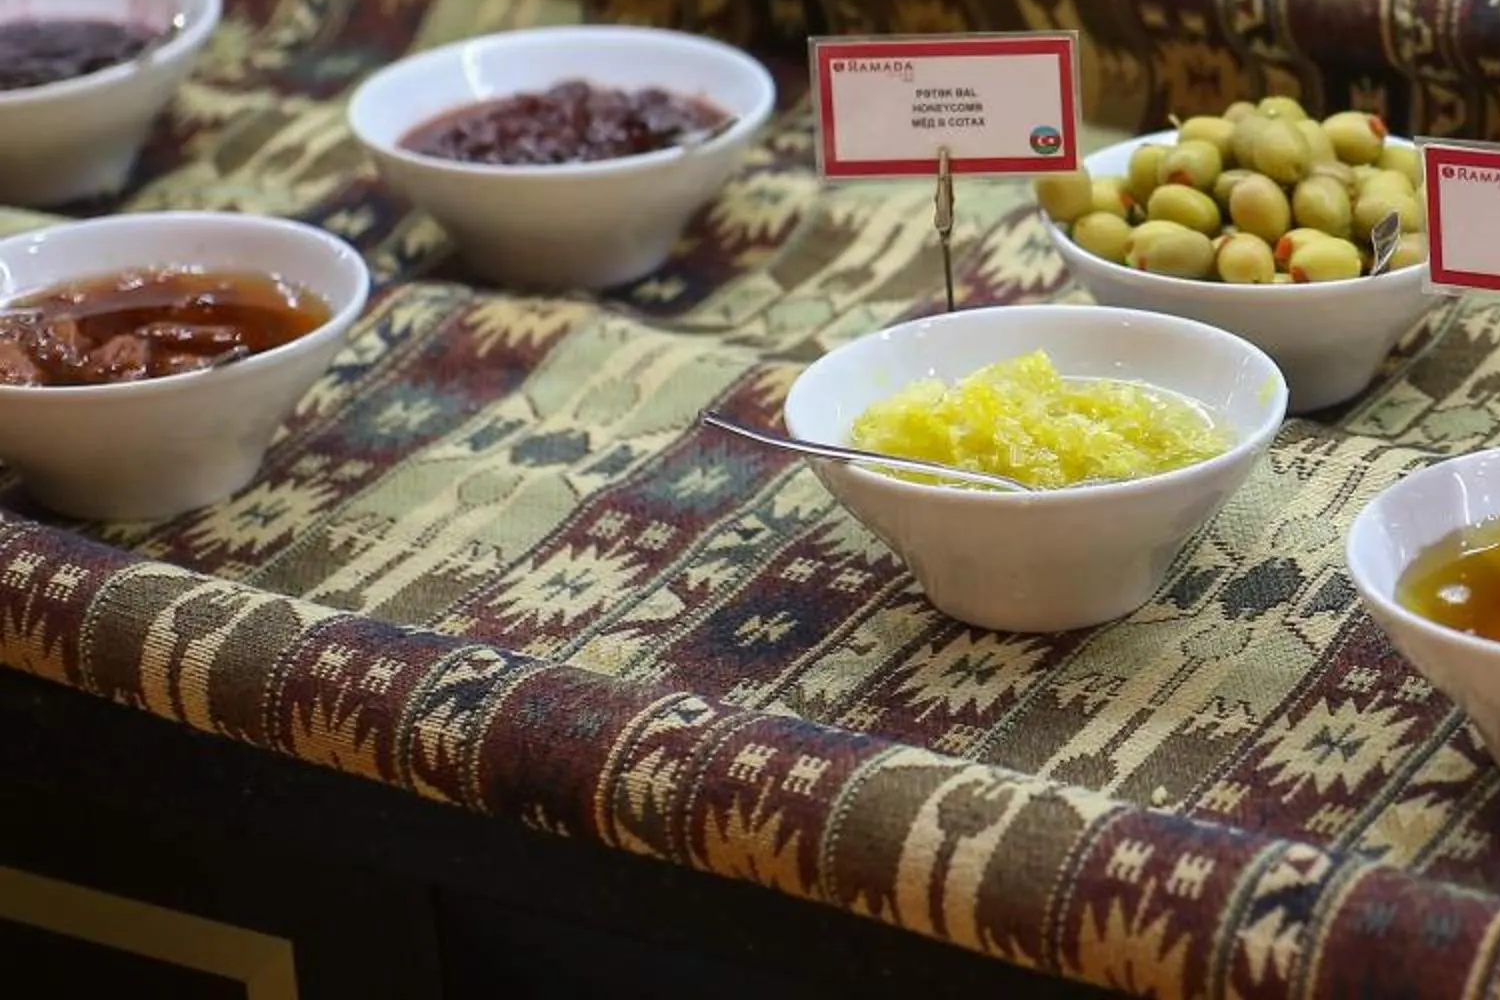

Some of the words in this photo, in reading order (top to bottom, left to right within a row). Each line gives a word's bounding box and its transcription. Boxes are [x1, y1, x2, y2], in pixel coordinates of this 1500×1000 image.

[847, 60, 913, 73] RAMADA
[955, 87, 977, 98] BAL
[912, 102, 983, 113] HONEYCOMB
